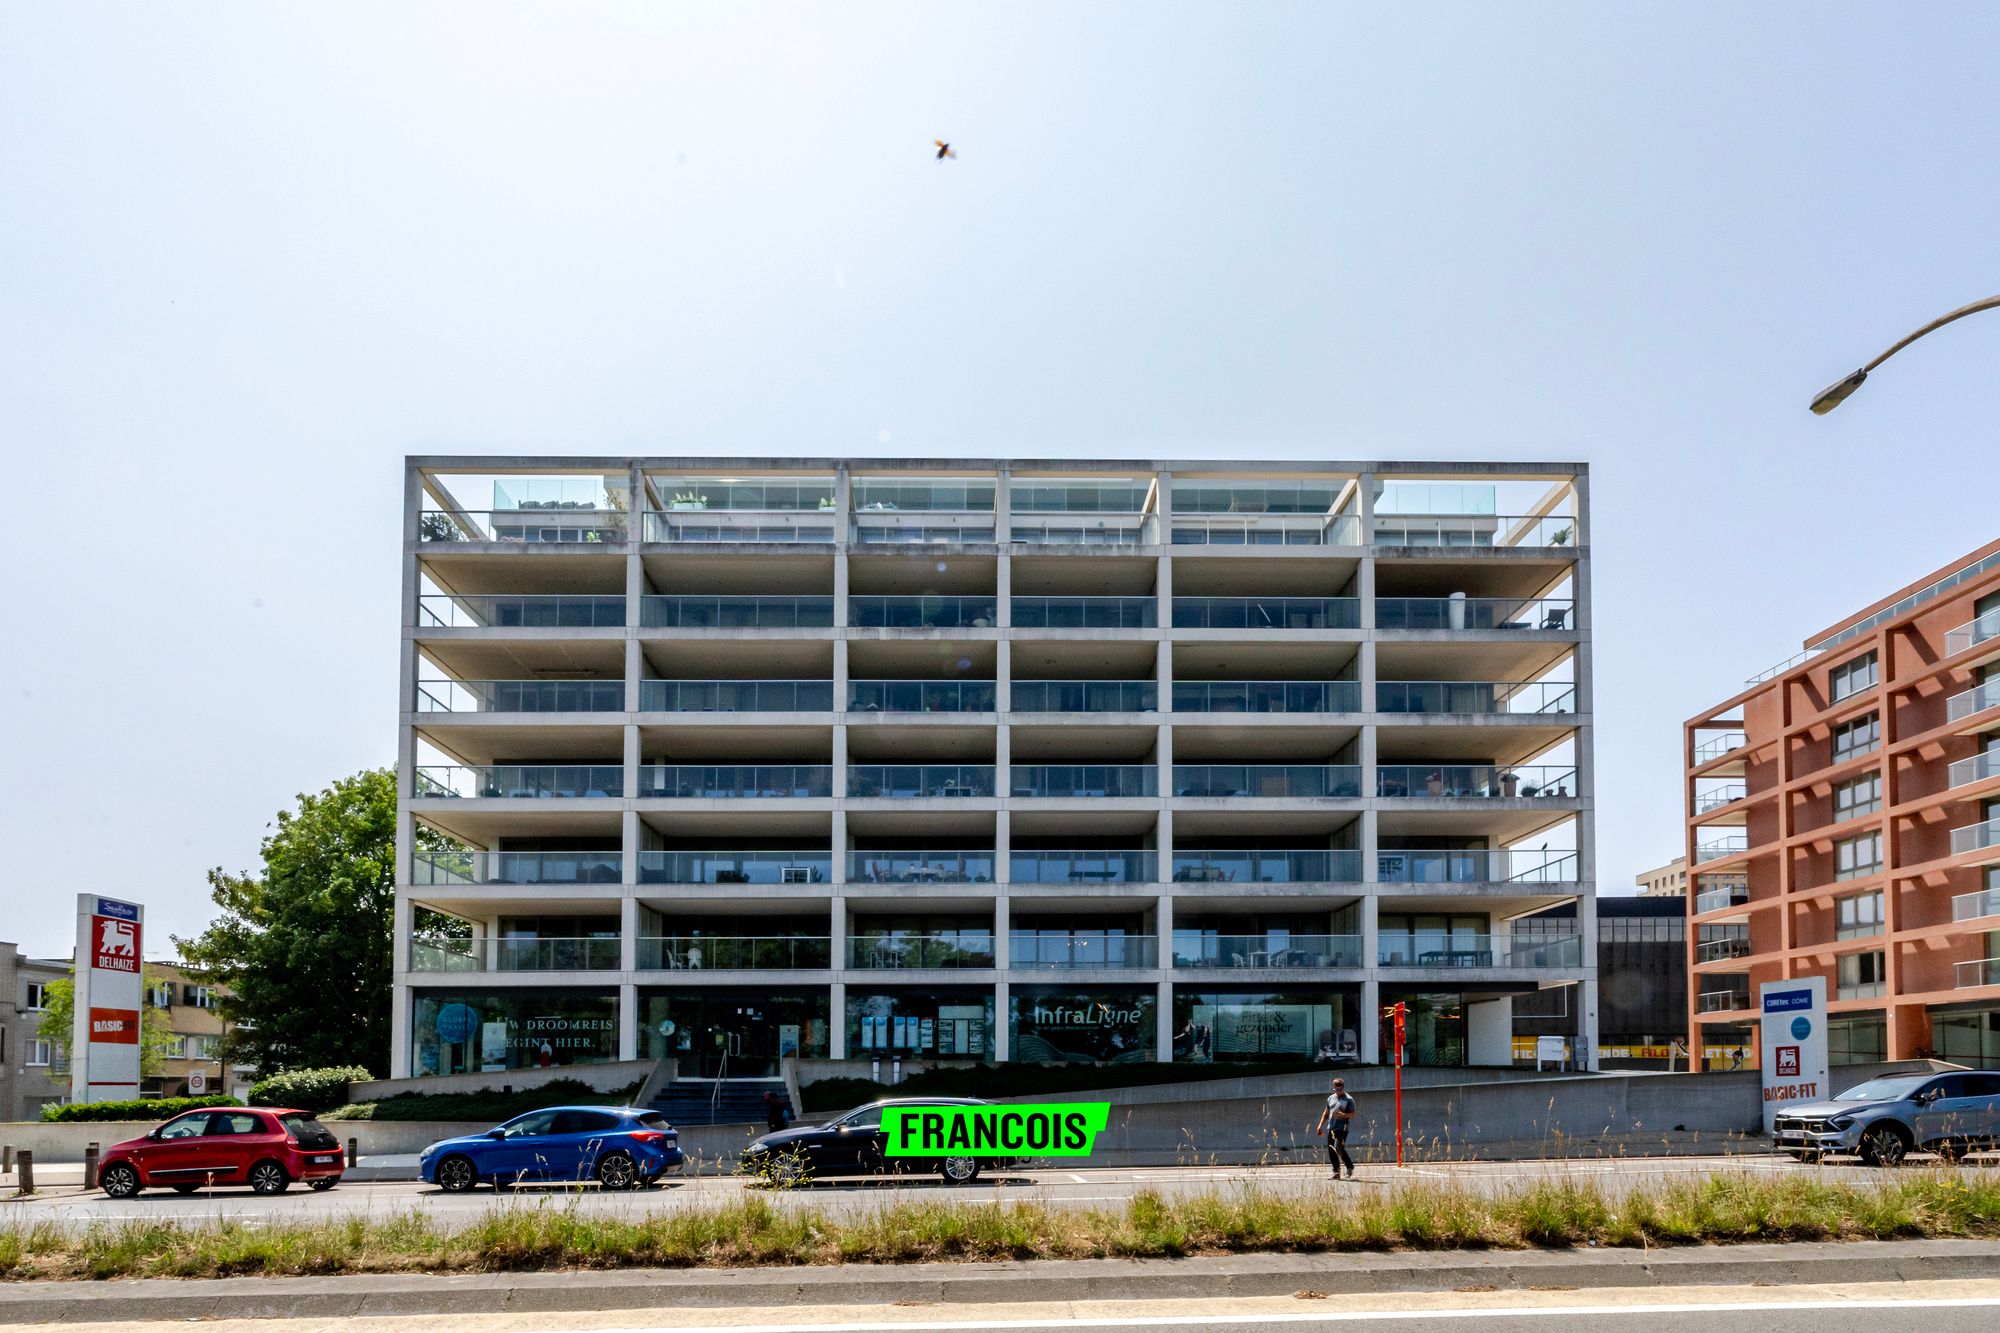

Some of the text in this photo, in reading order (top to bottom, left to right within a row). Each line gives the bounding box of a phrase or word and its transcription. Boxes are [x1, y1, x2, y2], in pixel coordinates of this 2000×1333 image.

[99, 956, 134, 971] DELHAIZE
[1034, 1002, 1141, 1028] InfraLigne
[527, 1020, 613, 1030] DROOMREIS
[1236, 1021, 1294, 1037] gezonder
[556, 1038, 595, 1048] HIER.
[1642, 1048, 1669, 1057] FILO
[1764, 1082, 1817, 1101] BASIC-FIT
